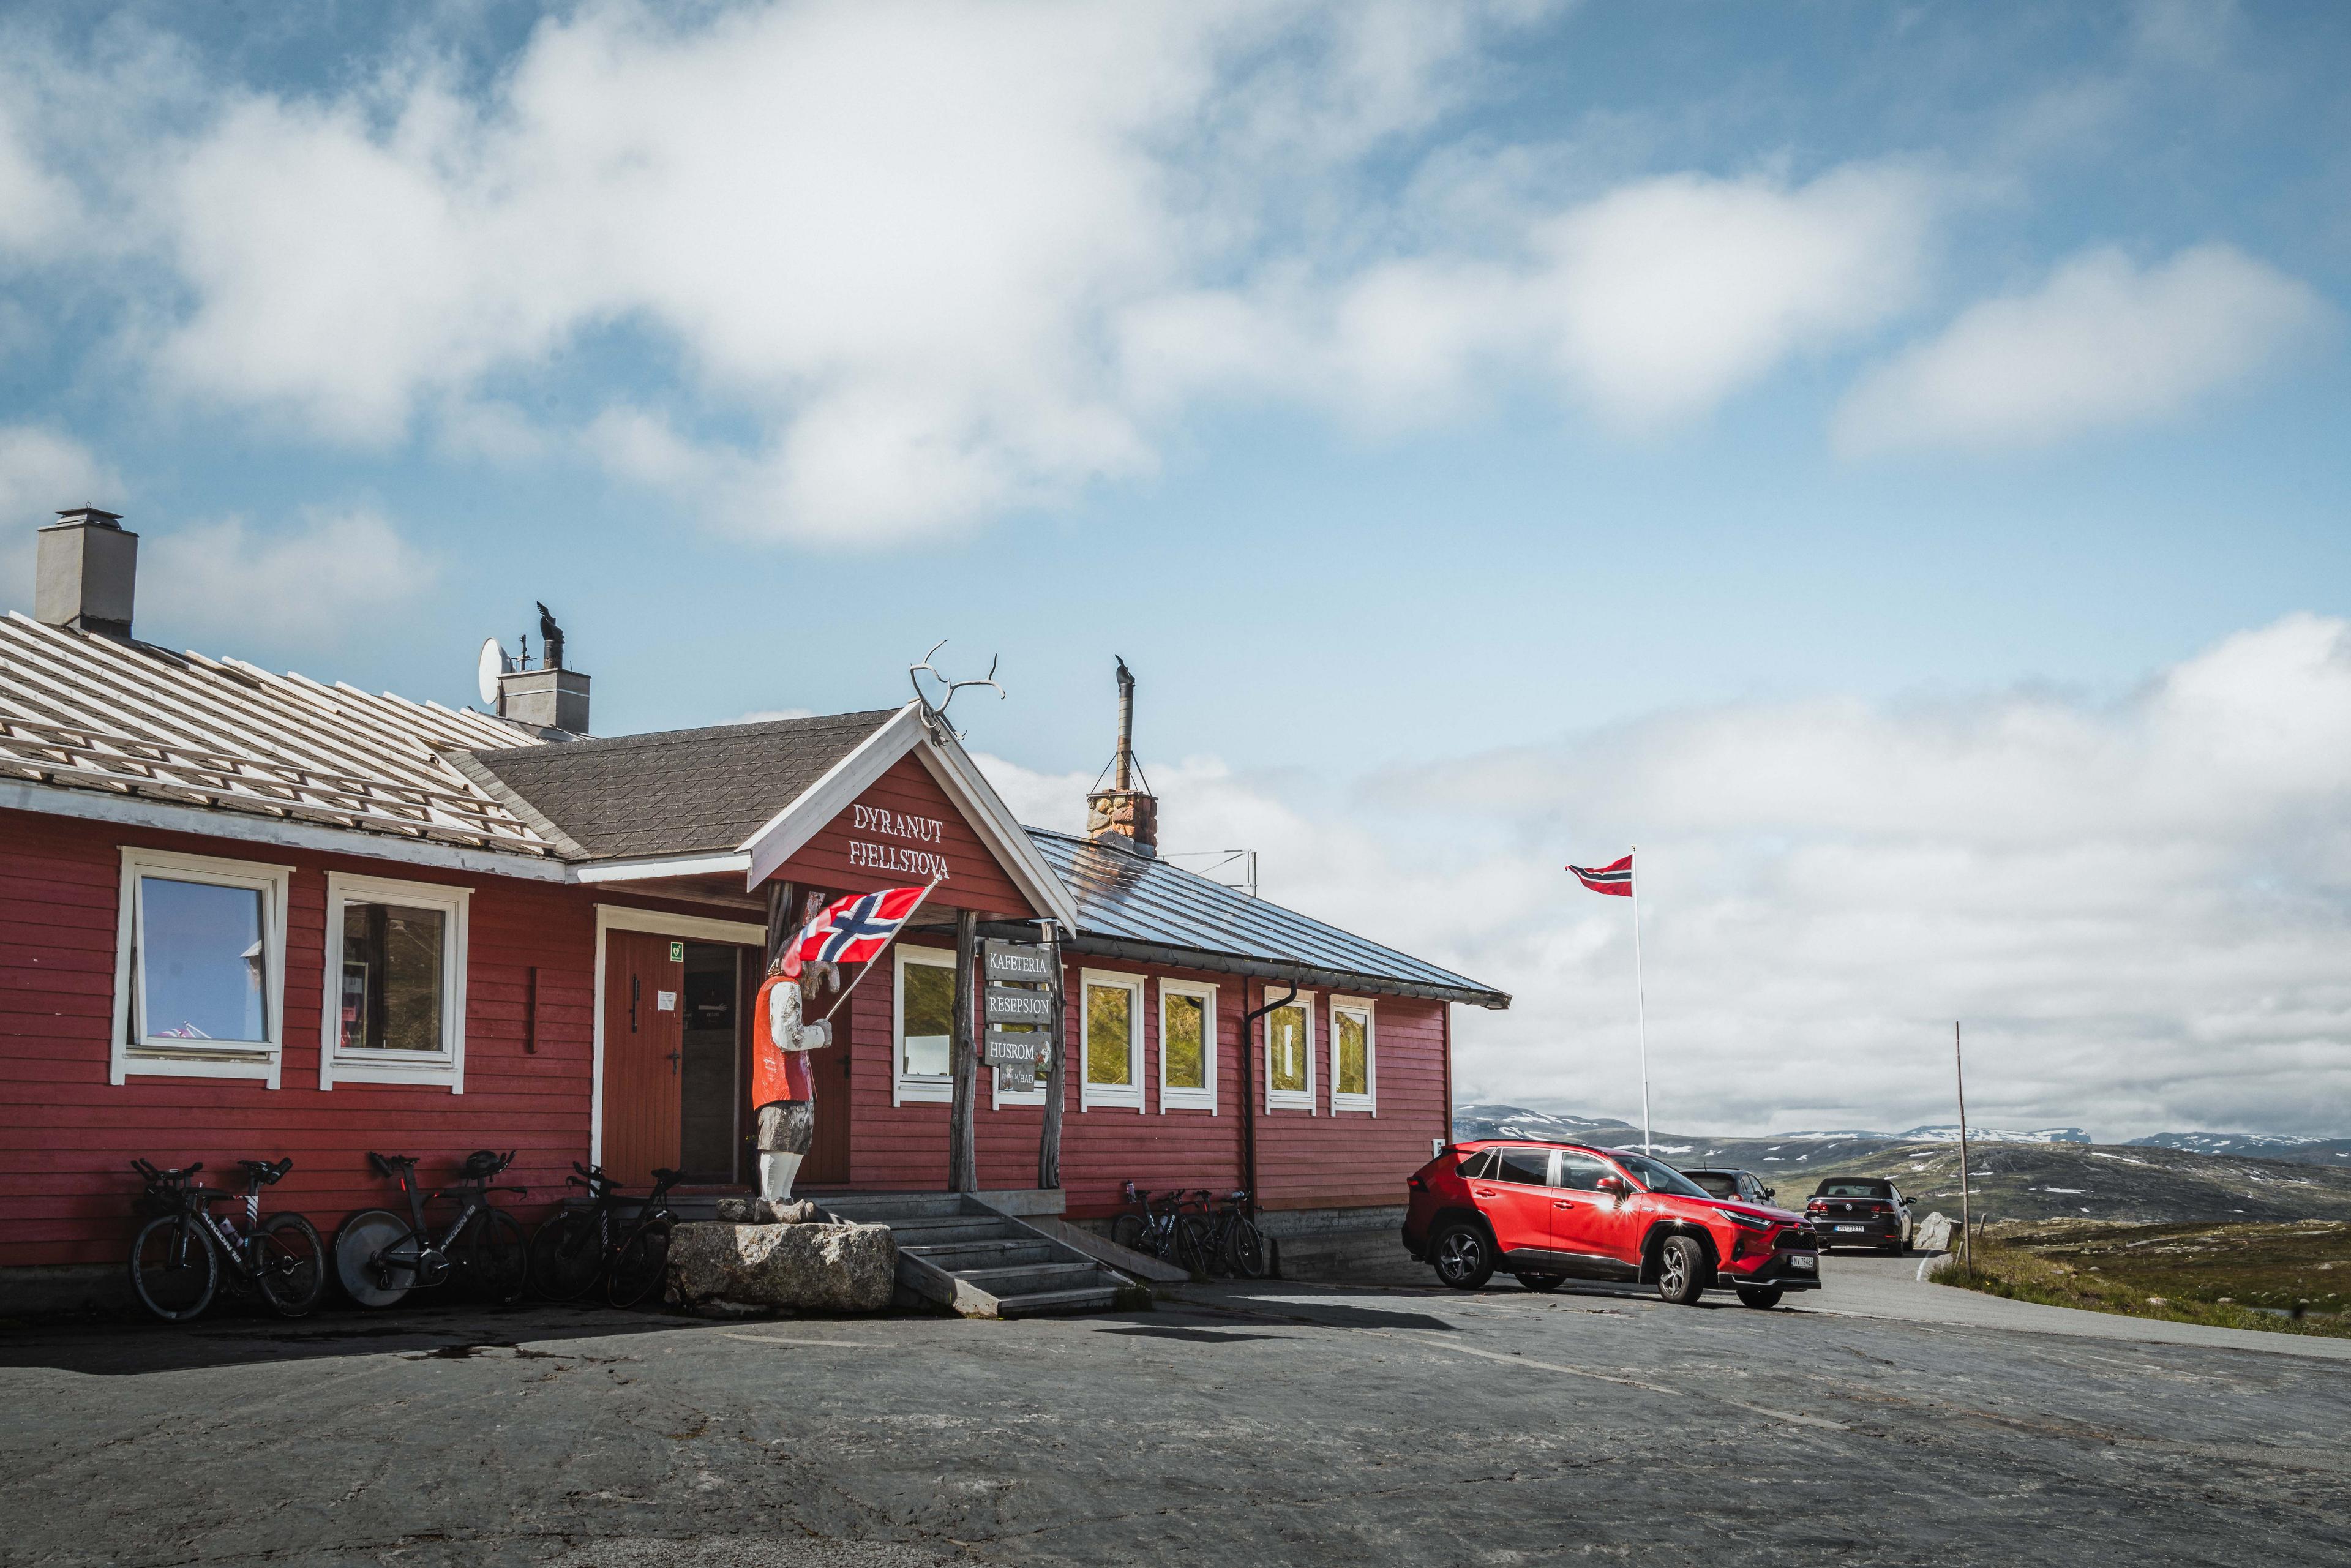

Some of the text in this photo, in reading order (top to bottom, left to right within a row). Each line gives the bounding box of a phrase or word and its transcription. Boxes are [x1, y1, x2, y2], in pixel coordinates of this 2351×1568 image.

[853, 804, 943, 844] DYRANUT
[849, 841, 950, 879] FJELLSTOVA
[989, 952, 1047, 973] KAFETERIA
[989, 997, 1049, 1014] RESEPSJON
[990, 1042, 1035, 1060] HUSROM
[201, 1212, 241, 1263] ARGON 18
[441, 1204, 476, 1253] ARGON 18
[1801, 1258, 1813, 1266] 79485
